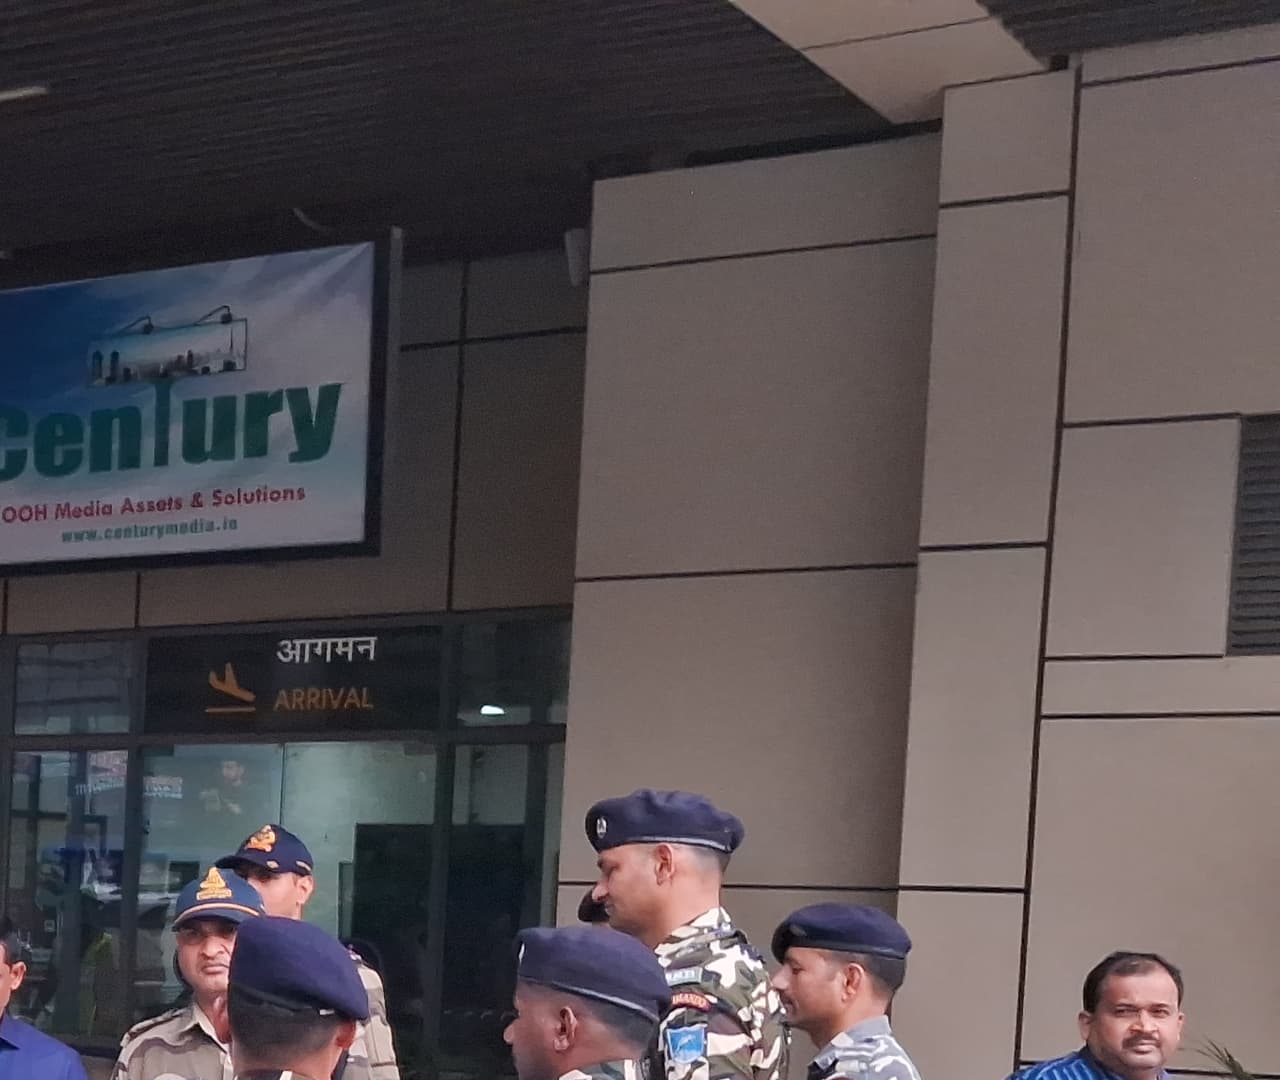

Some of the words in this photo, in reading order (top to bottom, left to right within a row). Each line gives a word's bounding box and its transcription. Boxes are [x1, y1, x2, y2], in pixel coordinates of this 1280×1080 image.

[1, 505, 47, 524] OOH
[54, 500, 113, 521] Media
[121, 496, 183, 515] Assets
[190, 491, 204, 509] &
[211, 484, 306, 507] Solutions
[276, 635, 378, 664] आगमन
[273, 686, 375, 712] ARRIVAL
